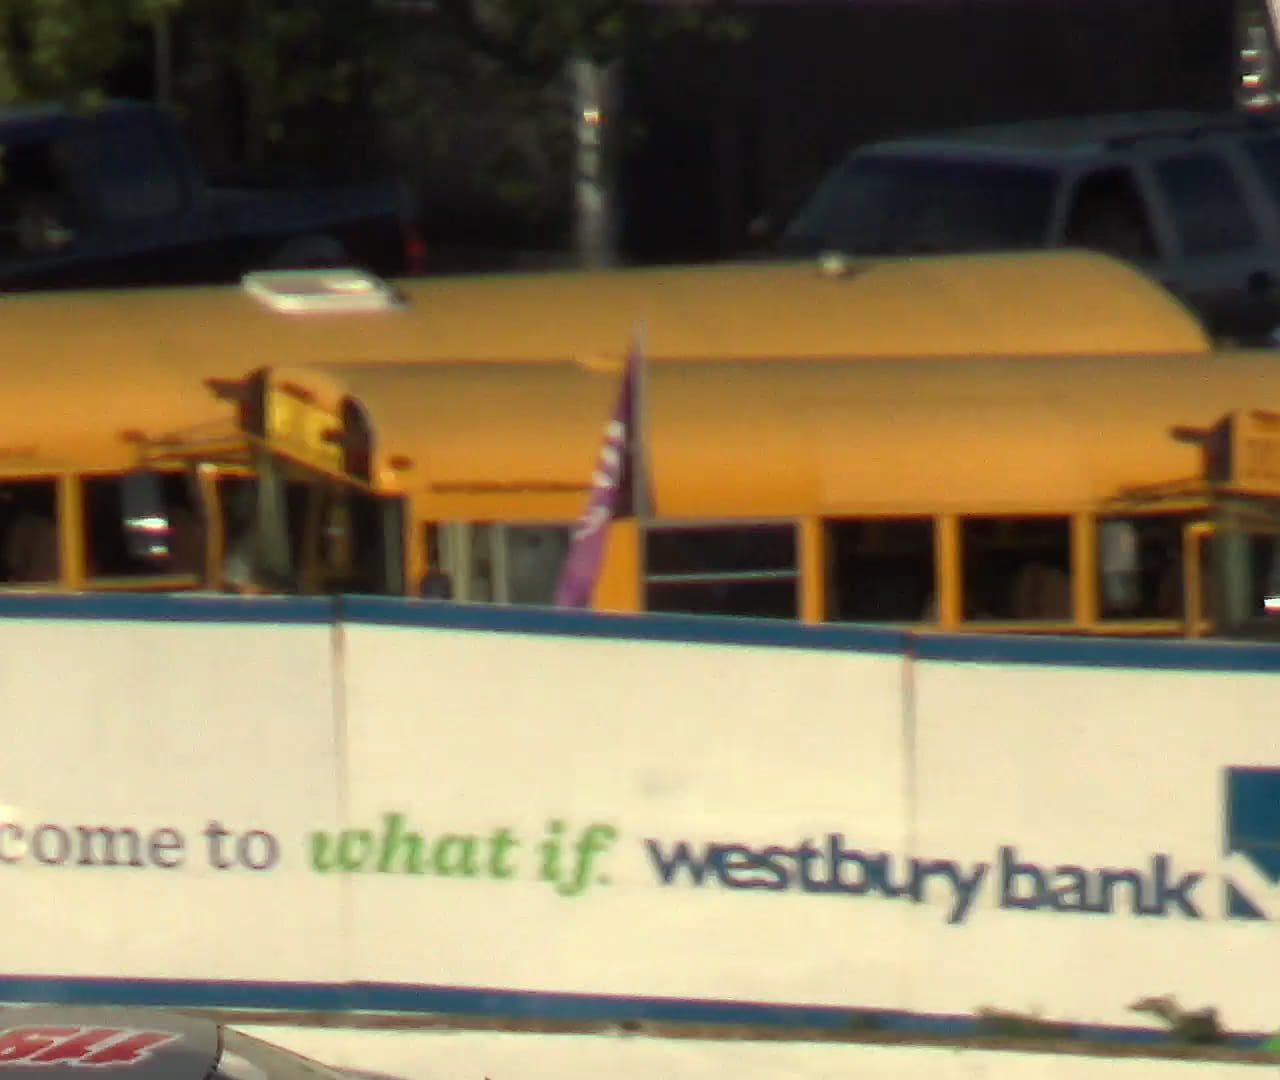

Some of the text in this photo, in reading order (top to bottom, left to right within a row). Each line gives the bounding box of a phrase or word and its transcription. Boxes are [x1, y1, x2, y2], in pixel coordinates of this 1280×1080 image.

[205, 819, 281, 871] to
[308, 811, 518, 880] what
[644, 833, 988, 925] westbury
[998, 845, 1207, 921] bank
